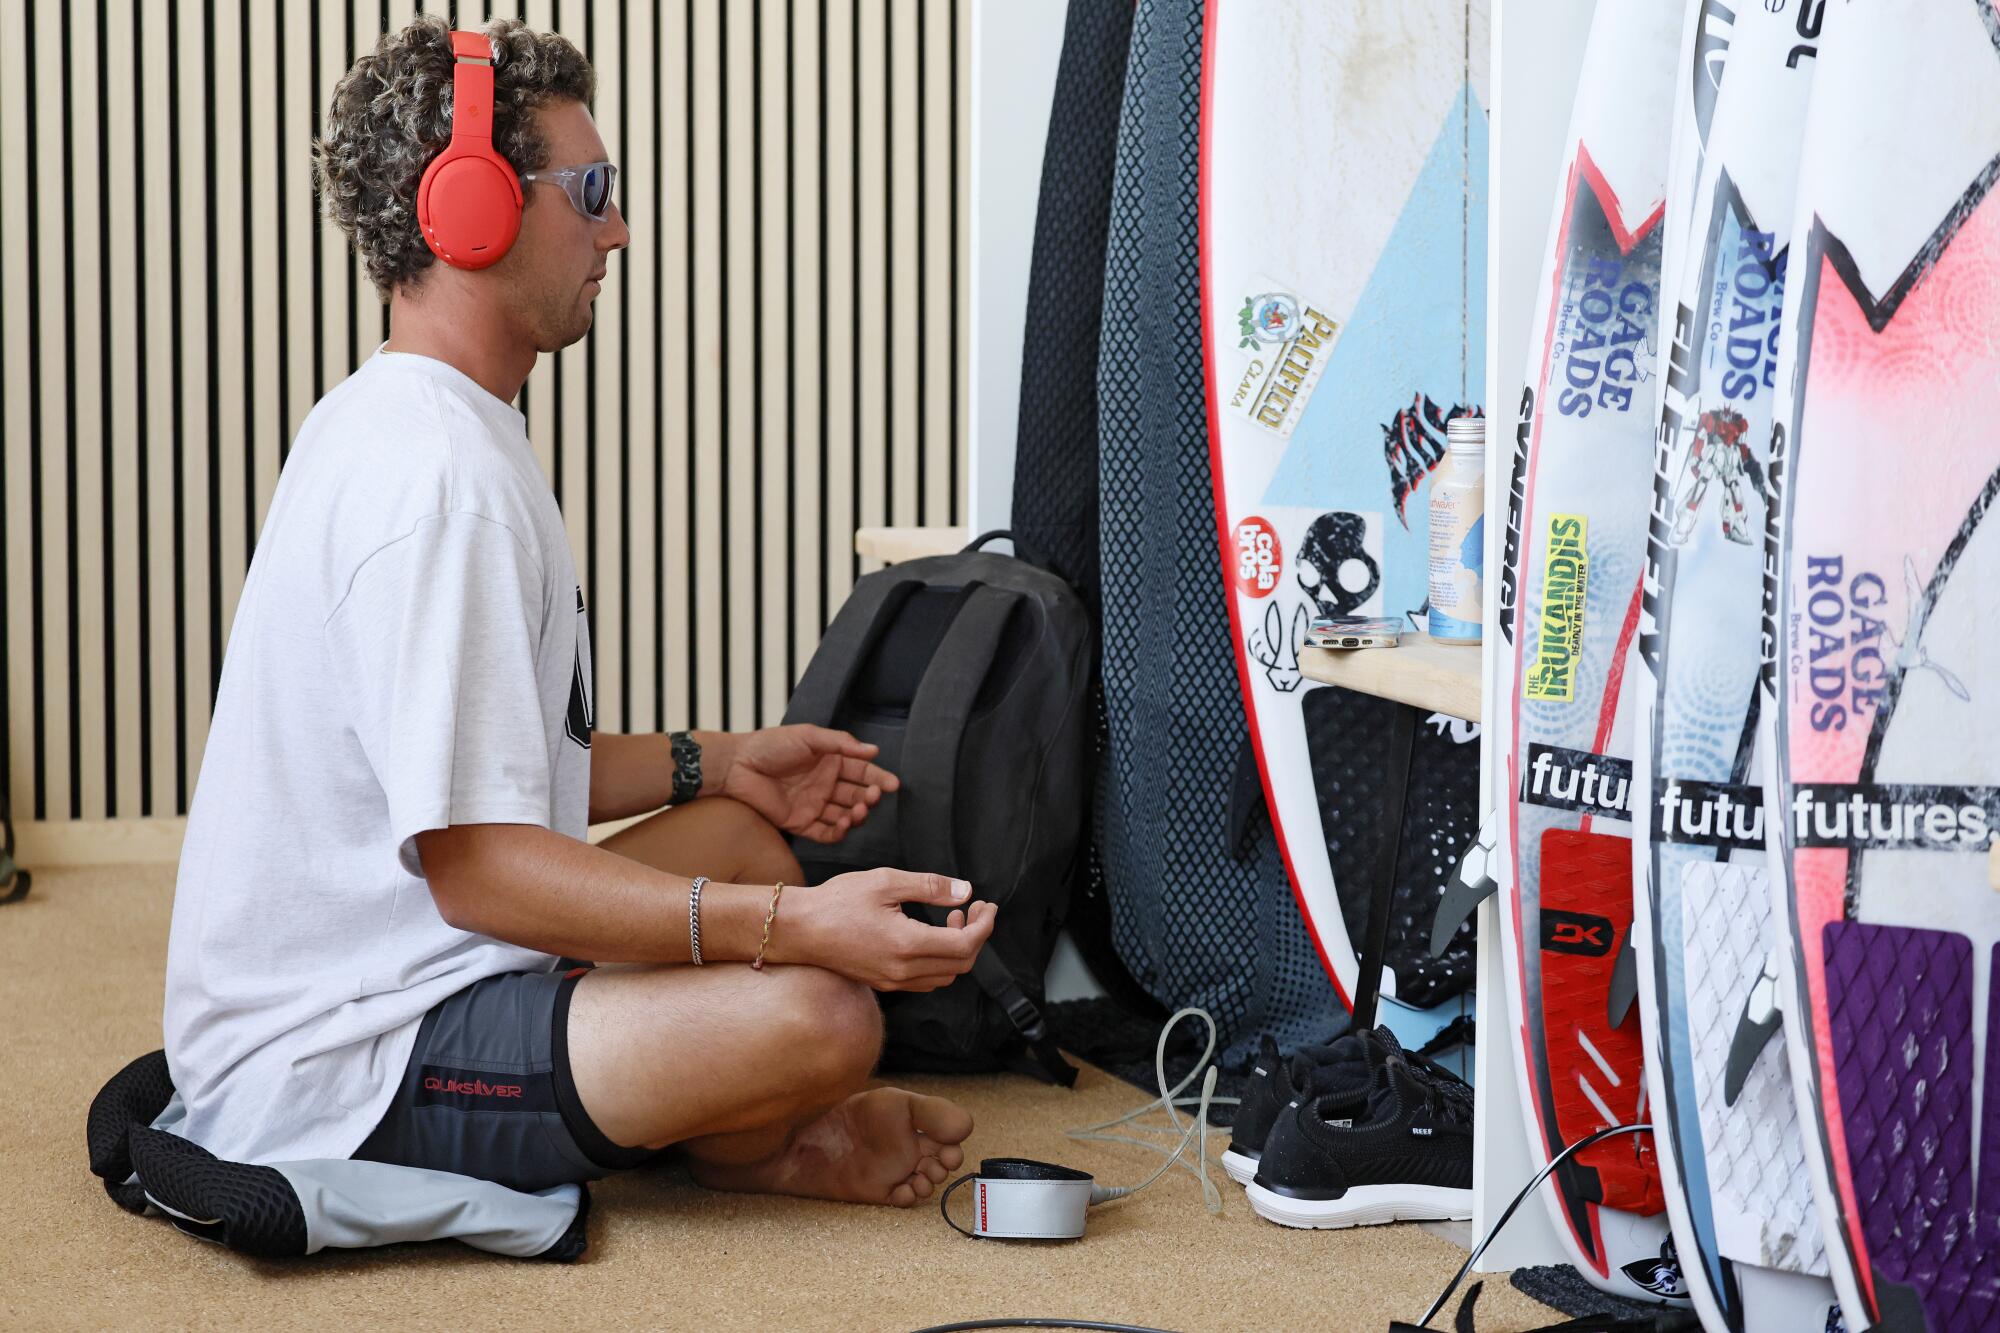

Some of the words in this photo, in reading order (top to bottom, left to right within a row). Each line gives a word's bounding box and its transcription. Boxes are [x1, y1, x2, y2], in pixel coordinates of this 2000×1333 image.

[1557, 304, 1573, 339] Brew
[1713, 281, 1728, 318] Brew
[1721, 229, 1775, 400] ROADS
[1552, 342, 1565, 359] Co
[1558, 256, 1623, 419] ROADS
[1597, 281, 1652, 412] GAGE
[1710, 321, 1722, 341] Co
[1230, 359, 1264, 408] CLARA
[1257, 306, 1338, 430] PACIFICO
[1500, 386, 1534, 647] SYNERGY
[1238, 524, 1261, 580] bros
[1257, 533, 1281, 589] cola
[1759, 421, 1786, 700] SYNERGY
[1576, 563, 1586, 593] WATER
[1538, 517, 1583, 697] IRUKANDJIS
[1574, 611, 1582, 621] IN
[1575, 594, 1583, 610] THE
[1572, 623, 1581, 656] DEADLY
[1790, 612, 1801, 652] Brew
[1807, 554, 1847, 732] ROADS
[1849, 572, 1887, 715] GAGE
[1527, 674, 1540, 697] THE
[1791, 655, 1803, 675] Co
[1412, 1127, 1433, 1136] REEF
